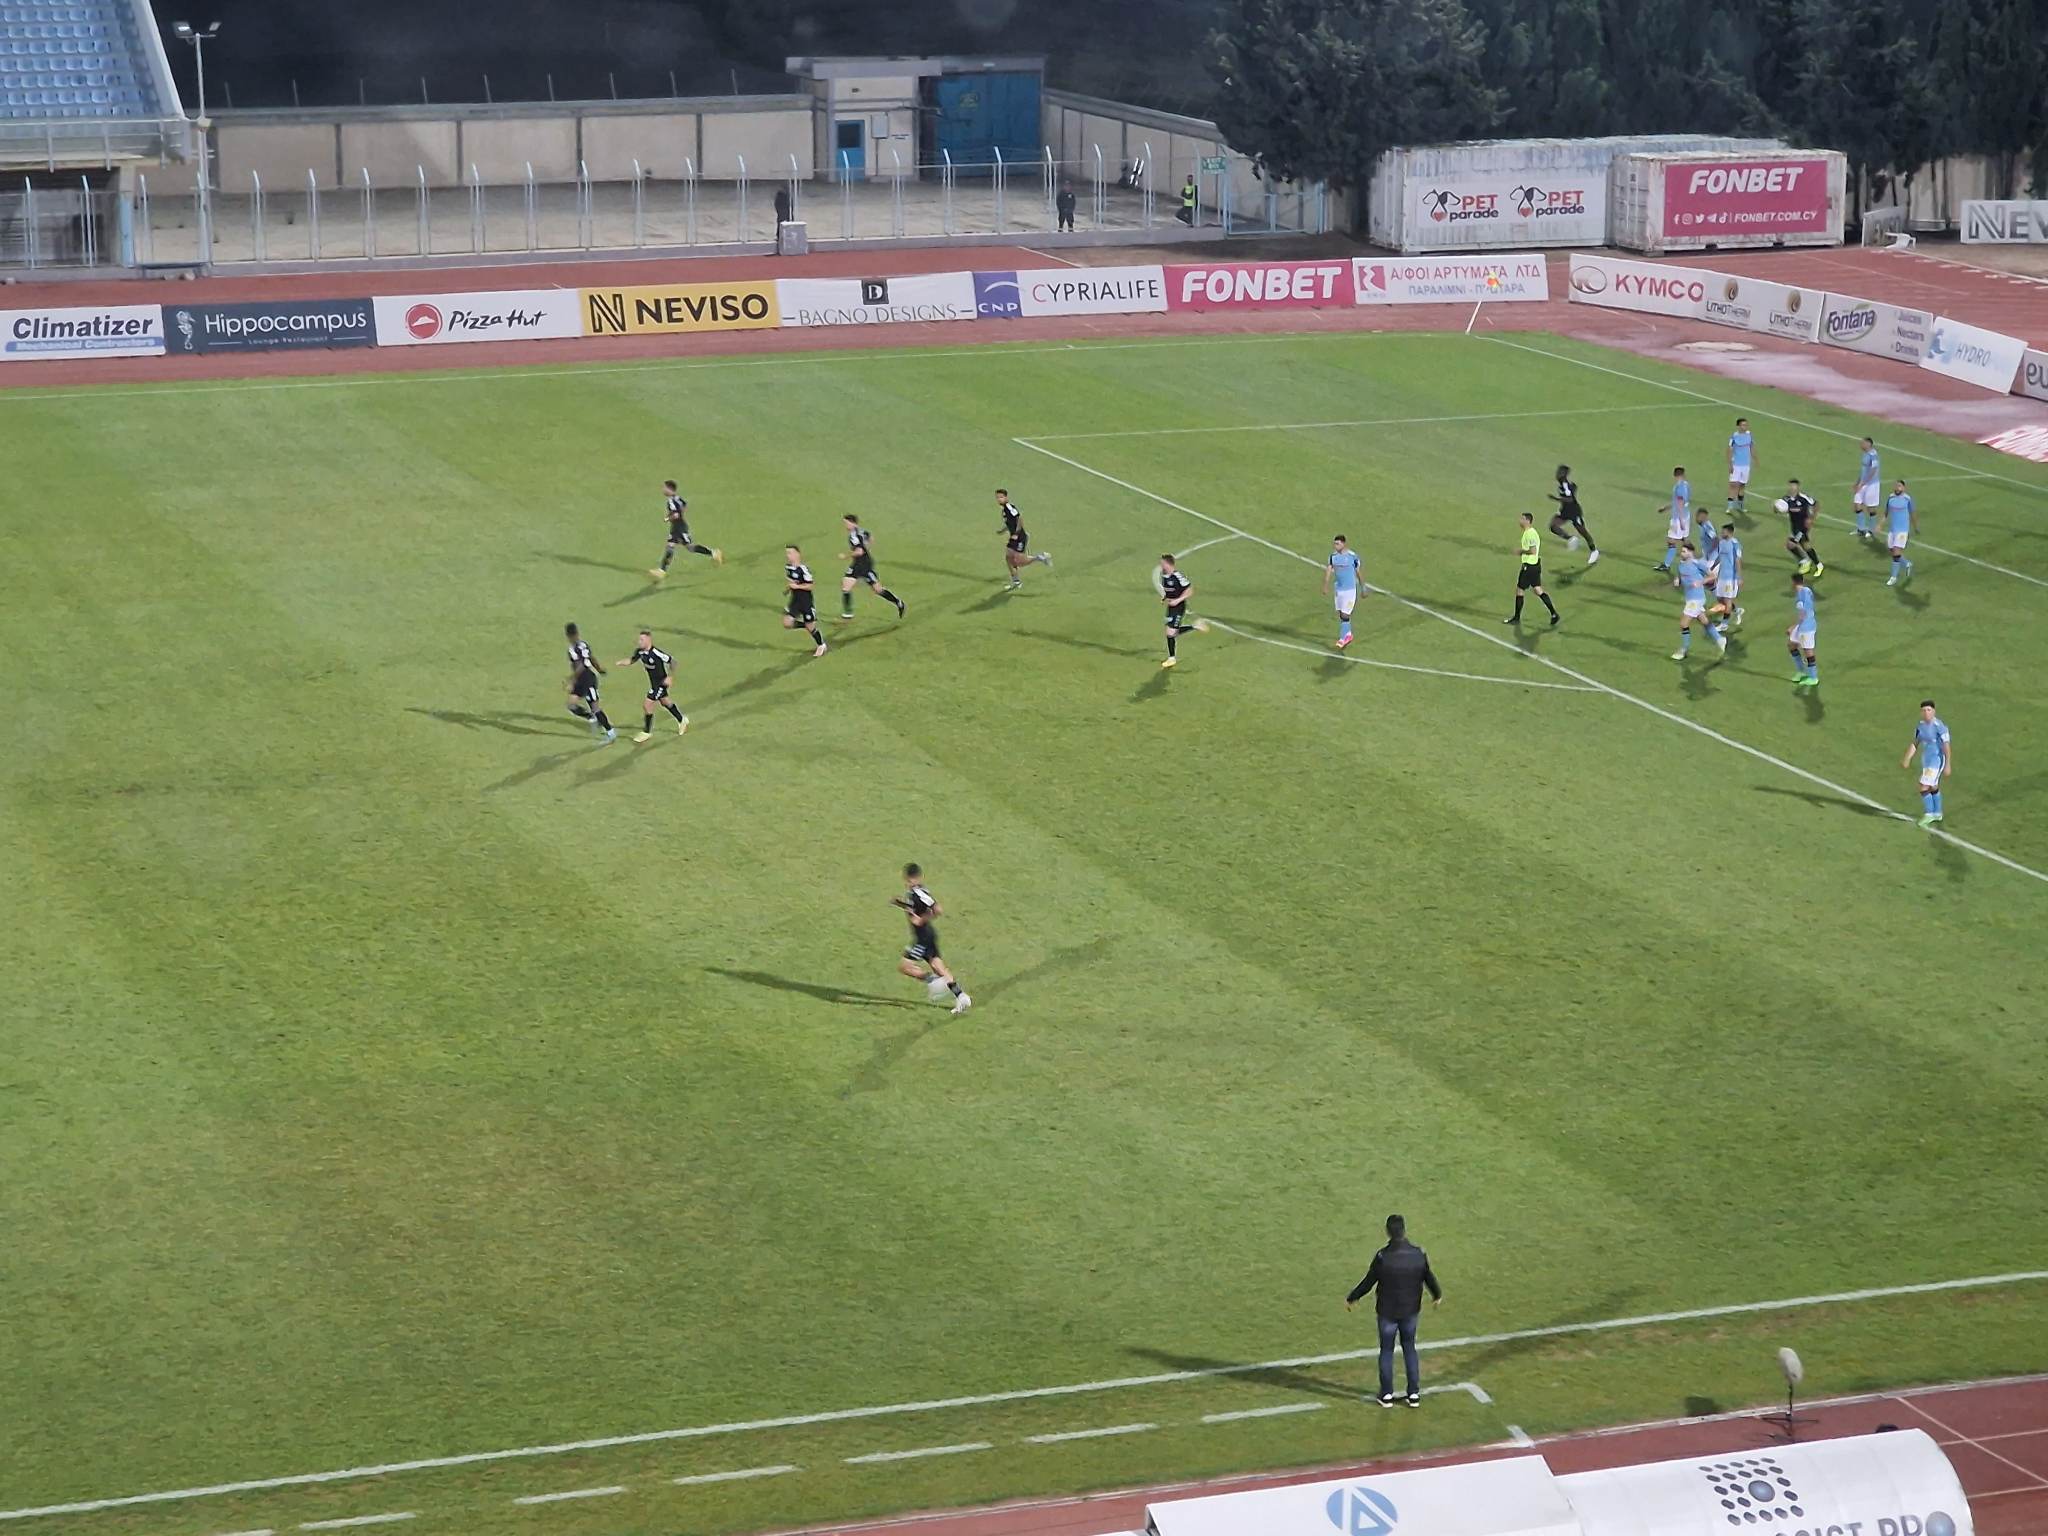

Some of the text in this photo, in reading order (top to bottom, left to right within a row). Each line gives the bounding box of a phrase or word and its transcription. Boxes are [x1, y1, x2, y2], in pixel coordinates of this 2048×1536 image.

[1688, 167, 1803, 194] FONBET
[1462, 194, 1498, 210] PET
[1548, 190, 1584, 206] PET
[1450, 208, 1499, 222] parade
[1536, 203, 1585, 218] parade
[1734, 210, 1818, 223] FONBET.COM.CY
[1033, 279, 1159, 303] CYPRIALIFE
[1182, 267, 1342, 303] FONBET
[1616, 273, 1704, 302] KYMCO
[635, 293, 768, 325] NEVISO
[800, 303, 957, 326] BAGNO DESIGNS
[978, 302, 1018, 313] CNP
[13, 315, 153, 339] Climatizer
[205, 312, 367, 337] Hippocampus
[448, 308, 548, 332] Pizza Hut
[1827, 309, 1876, 333] Fontana
[1955, 341, 1992, 368] HYDRO
